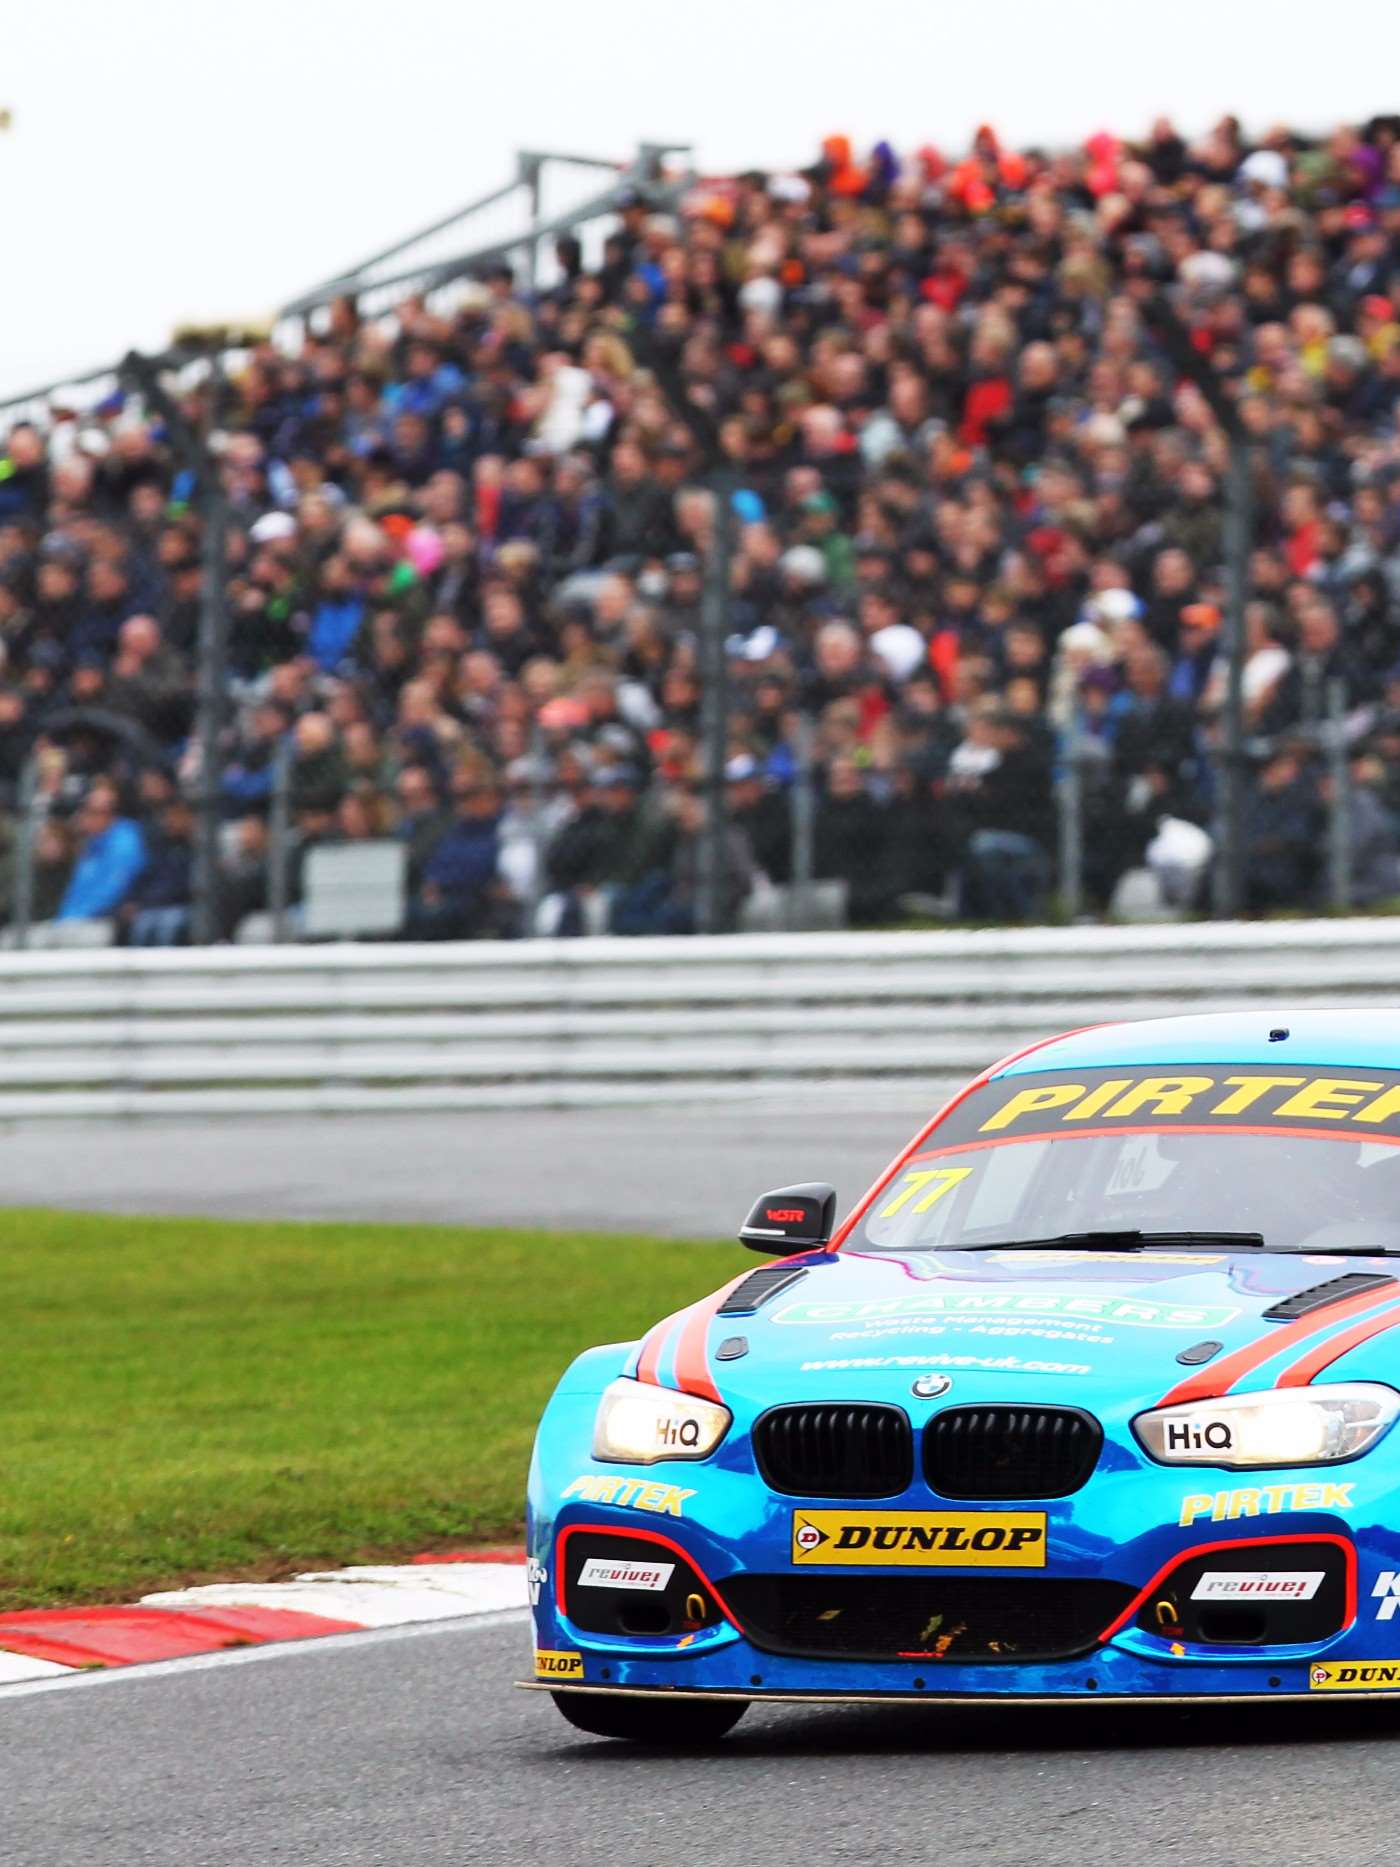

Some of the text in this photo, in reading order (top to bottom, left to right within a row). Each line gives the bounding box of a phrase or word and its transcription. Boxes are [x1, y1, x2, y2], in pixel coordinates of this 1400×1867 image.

[879, 1167, 975, 1218] 77
[805, 1296, 1210, 1322] CHAMBERS
[829, 1325, 947, 1341] Recycling
[969, 1325, 1115, 1344] Aggregates
[943, 1315, 1105, 1332] Management
[801, 1352, 1093, 1376] www.revive-uk.com
[656, 1419, 699, 1447] HiQ
[1168, 1422, 1233, 1450] HiQ
[561, 1475, 698, 1517] PIRTEK
[1179, 1483, 1356, 1527] PIRTEK
[833, 1526, 1043, 1551] DUNLOP
